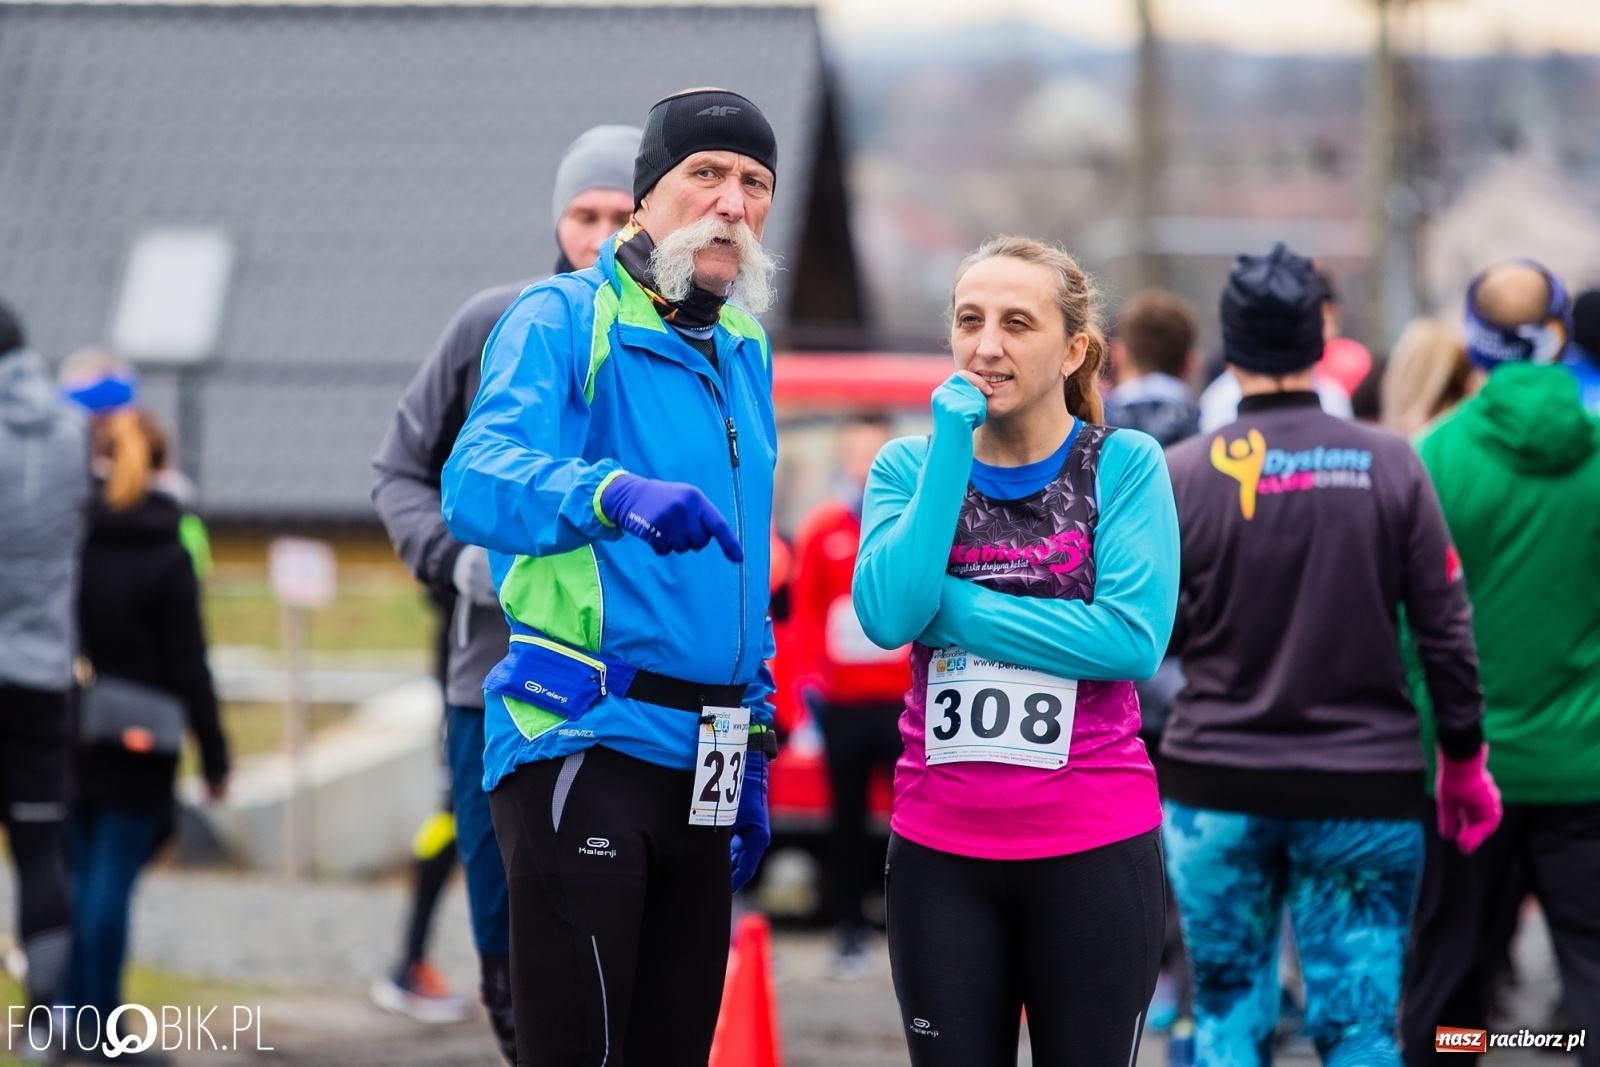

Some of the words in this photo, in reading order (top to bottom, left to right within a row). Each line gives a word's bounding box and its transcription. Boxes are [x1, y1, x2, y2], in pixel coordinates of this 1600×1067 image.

[695, 105, 742, 117] 4F
[1263, 444, 1373, 478] Dystans
[950, 543, 1051, 566] Kobiety
[541, 688, 569, 704] Kalenji
[932, 687, 1063, 745] 308
[698, 750, 746, 804] 23
[578, 846, 617, 859] Kalenji
[909, 1024, 939, 1038] Kalenji
